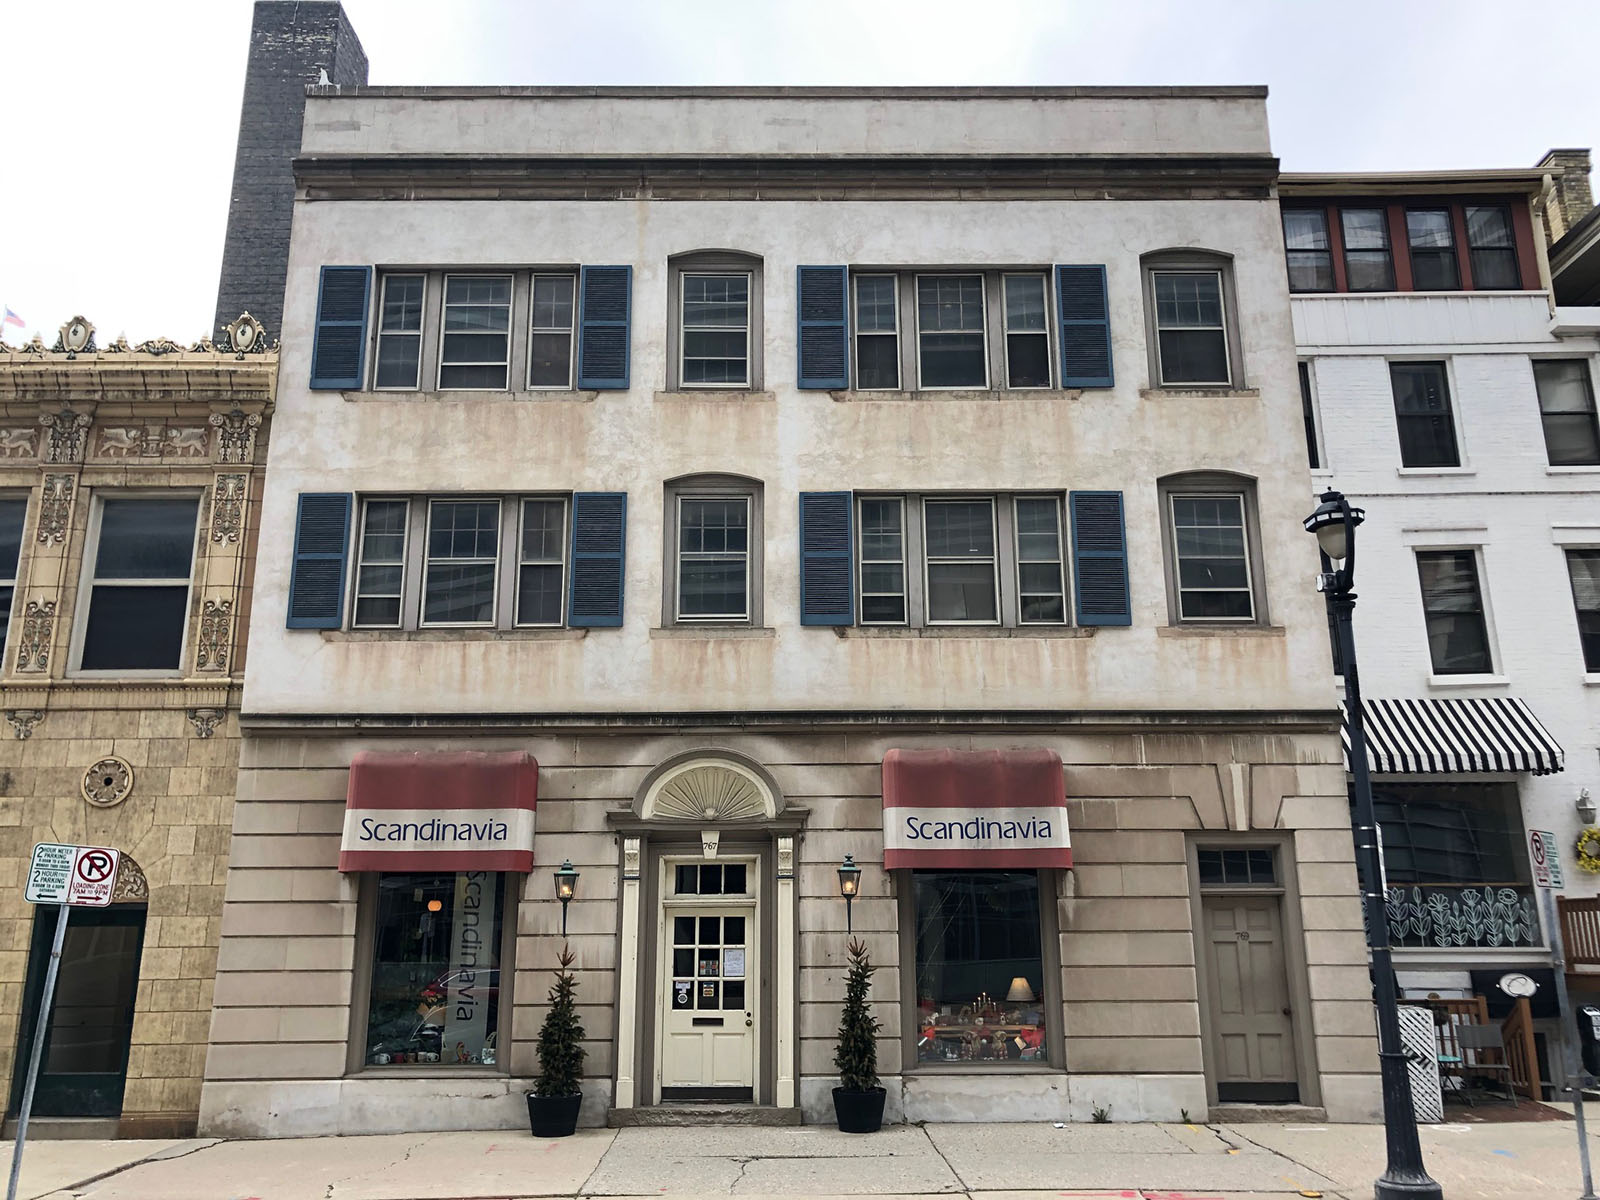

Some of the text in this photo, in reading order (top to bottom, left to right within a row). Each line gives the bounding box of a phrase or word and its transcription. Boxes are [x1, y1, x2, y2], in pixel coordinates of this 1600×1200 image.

[360, 818, 508, 841] Scandinavia
[906, 816, 1052, 840] Scandinavia
[703, 841, 718, 850] 767
[36, 846, 44, 858] 2
[33, 870, 41, 882] 2
[40, 876, 65, 884] PARKING
[1235, 931, 1250, 941] 769
[456, 871, 487, 1021] Scandinavia
